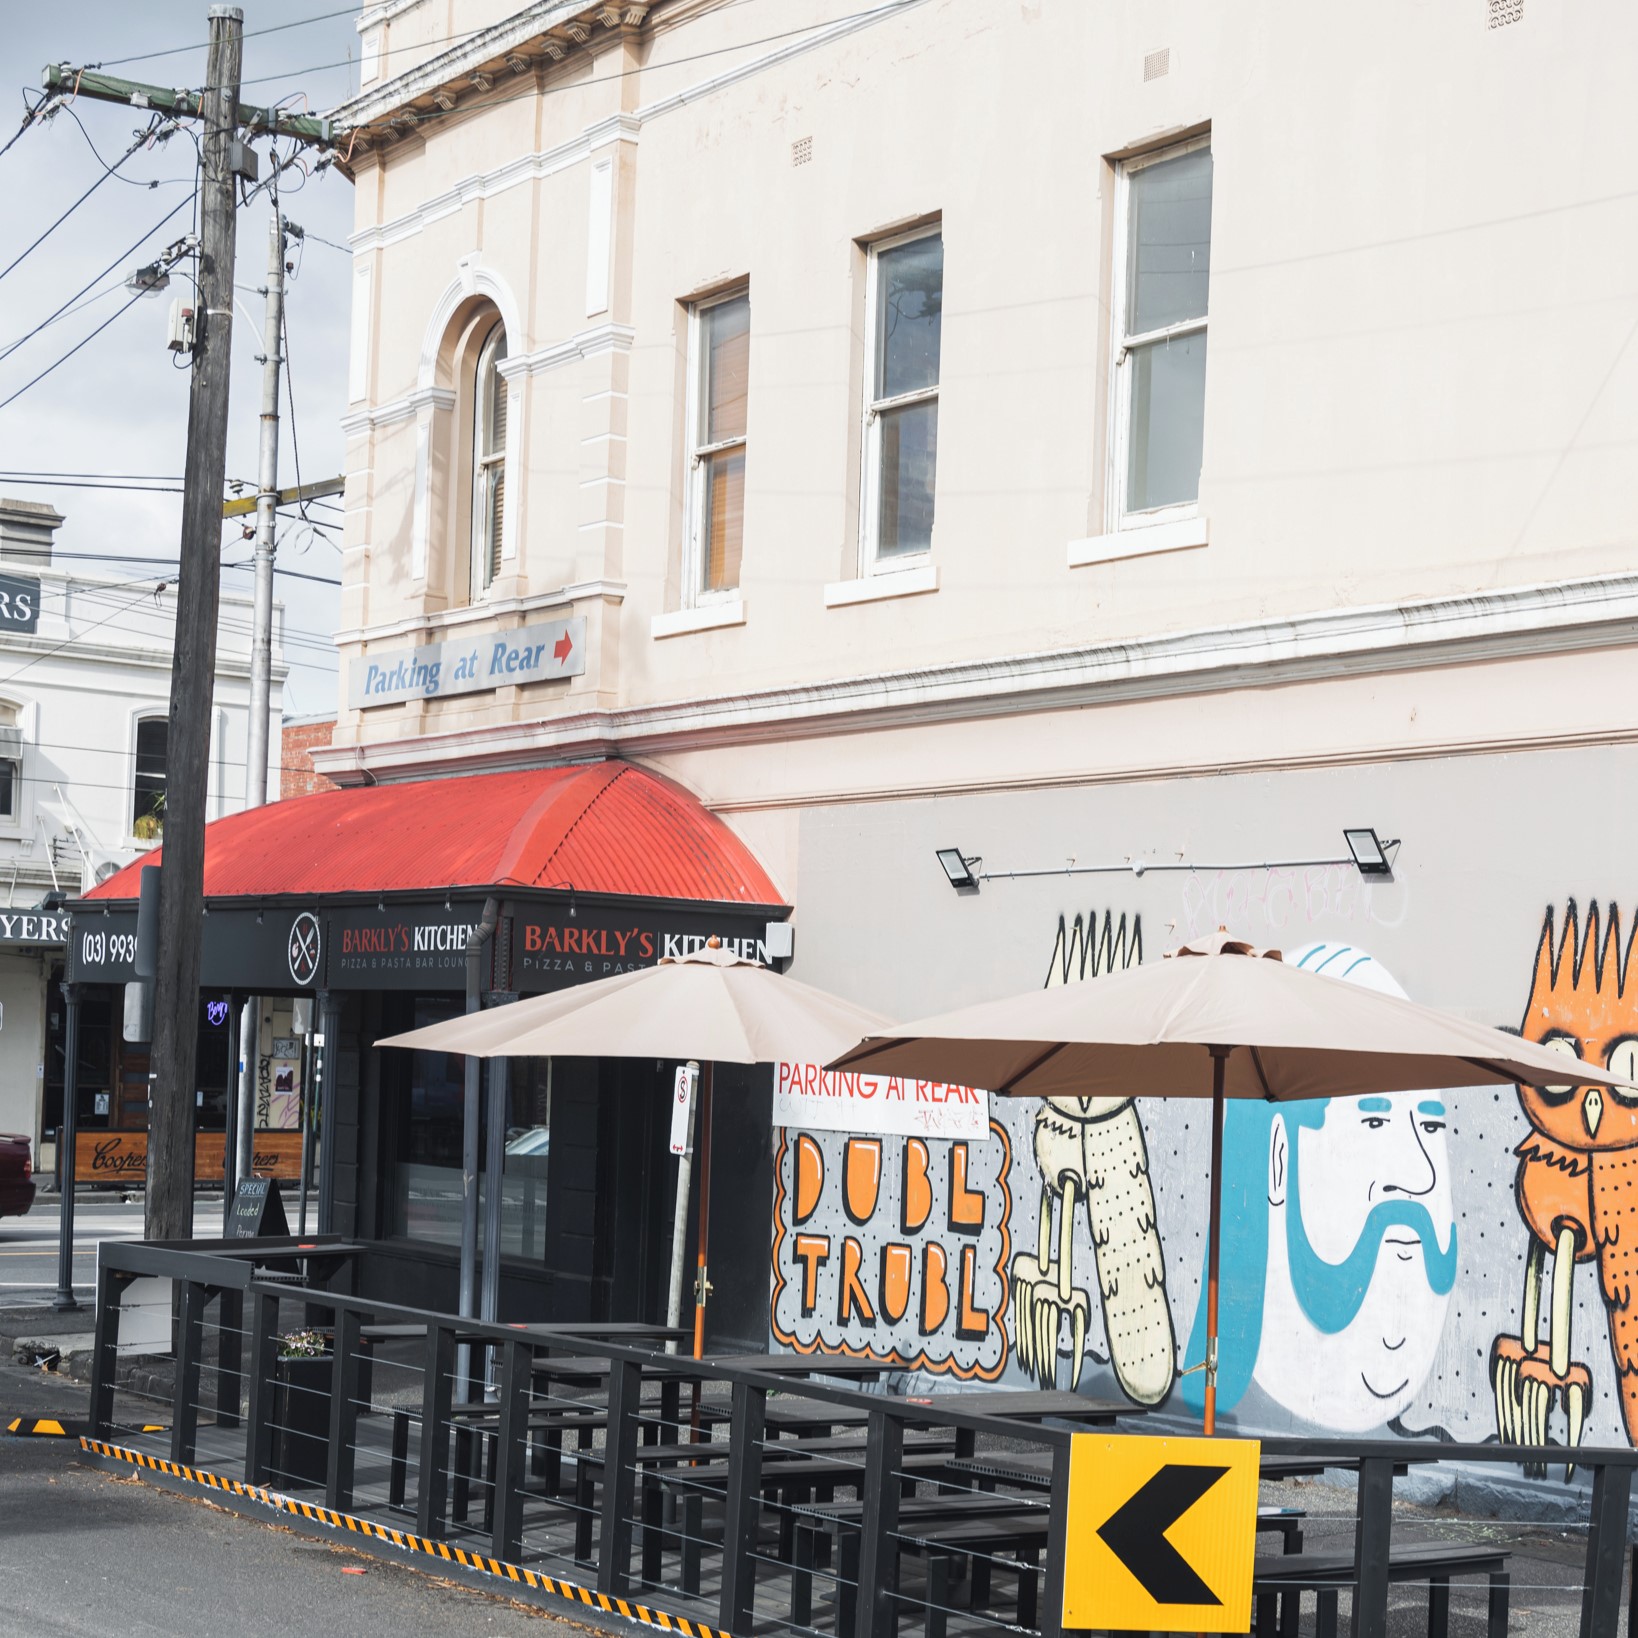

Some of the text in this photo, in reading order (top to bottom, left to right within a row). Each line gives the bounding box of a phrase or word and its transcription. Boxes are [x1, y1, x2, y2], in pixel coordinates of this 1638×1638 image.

[364, 641, 546, 695] Parking at Rear
[82, 931, 138, 966] (03) 993
[342, 923, 410, 953] BARKLY'S
[525, 925, 654, 958] BARKLY'S
[341, 958, 367, 969] PIZZA
[371, 958, 377, 968] &
[381, 957, 411, 969] PASTA
[415, 957, 434, 968] BAR
[523, 957, 646, 974] PIZZA & PAST
[779, 1062, 879, 1099] PARKING
[92, 1137, 147, 1174] Cooper
[792, 1132, 986, 1237] DUBL
[792, 1232, 990, 1341] TRUBL
